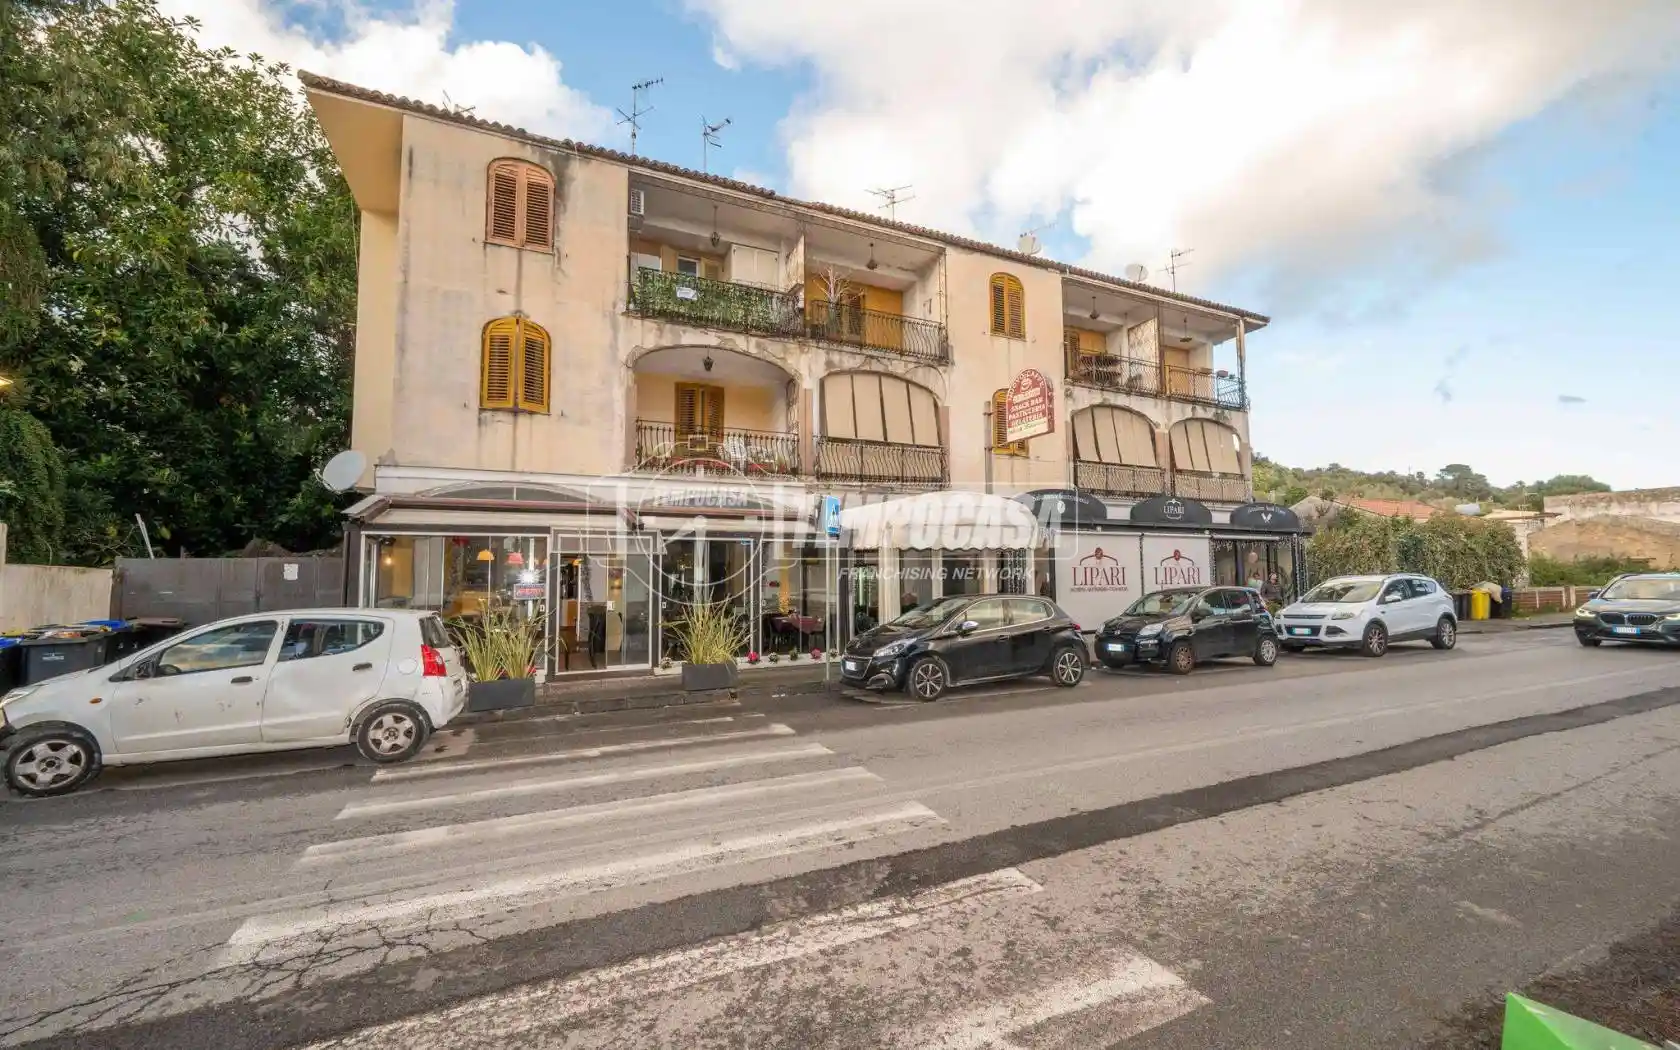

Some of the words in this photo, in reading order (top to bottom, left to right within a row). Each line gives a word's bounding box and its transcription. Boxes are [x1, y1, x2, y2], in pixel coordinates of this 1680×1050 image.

[1030, 396, 1044, 405] BAR
[1163, 505, 1185, 515] LIPARI
[1072, 566, 1127, 586] LIPARI
[1153, 566, 1201, 585] LIPARI
